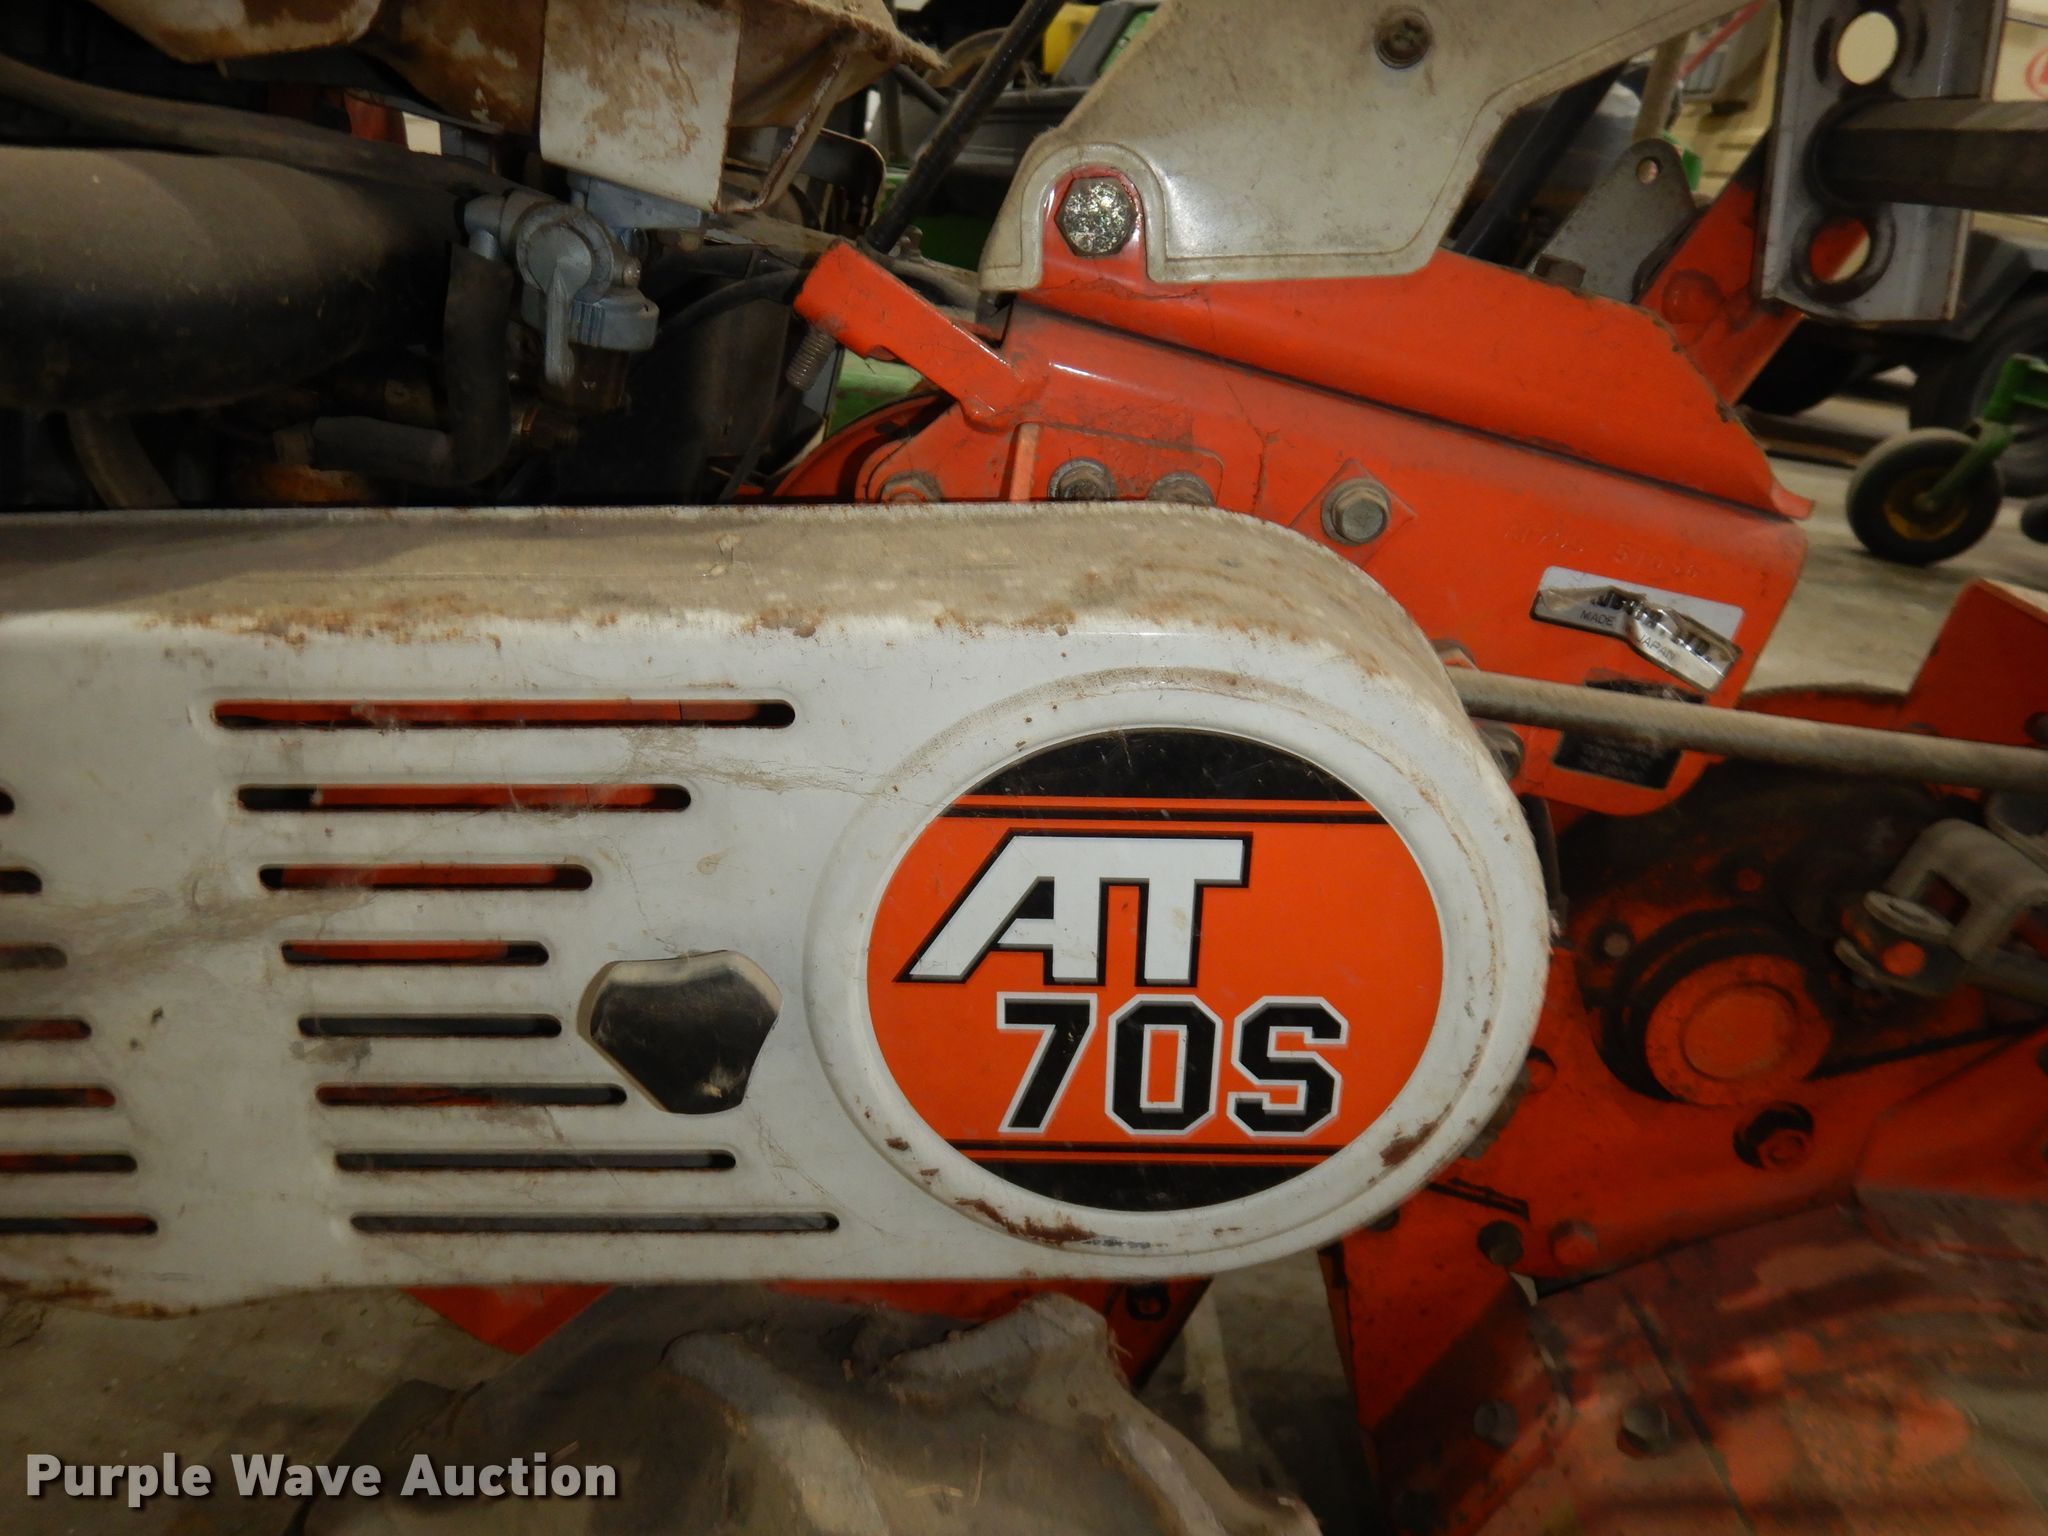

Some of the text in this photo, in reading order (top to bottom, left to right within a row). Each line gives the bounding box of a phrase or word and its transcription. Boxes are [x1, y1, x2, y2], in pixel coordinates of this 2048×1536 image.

[1579, 610, 1617, 627] MADE
[1636, 633, 1676, 662] JAPAN
[894, 828, 1253, 986] AT
[997, 992, 1349, 1137] 70S
